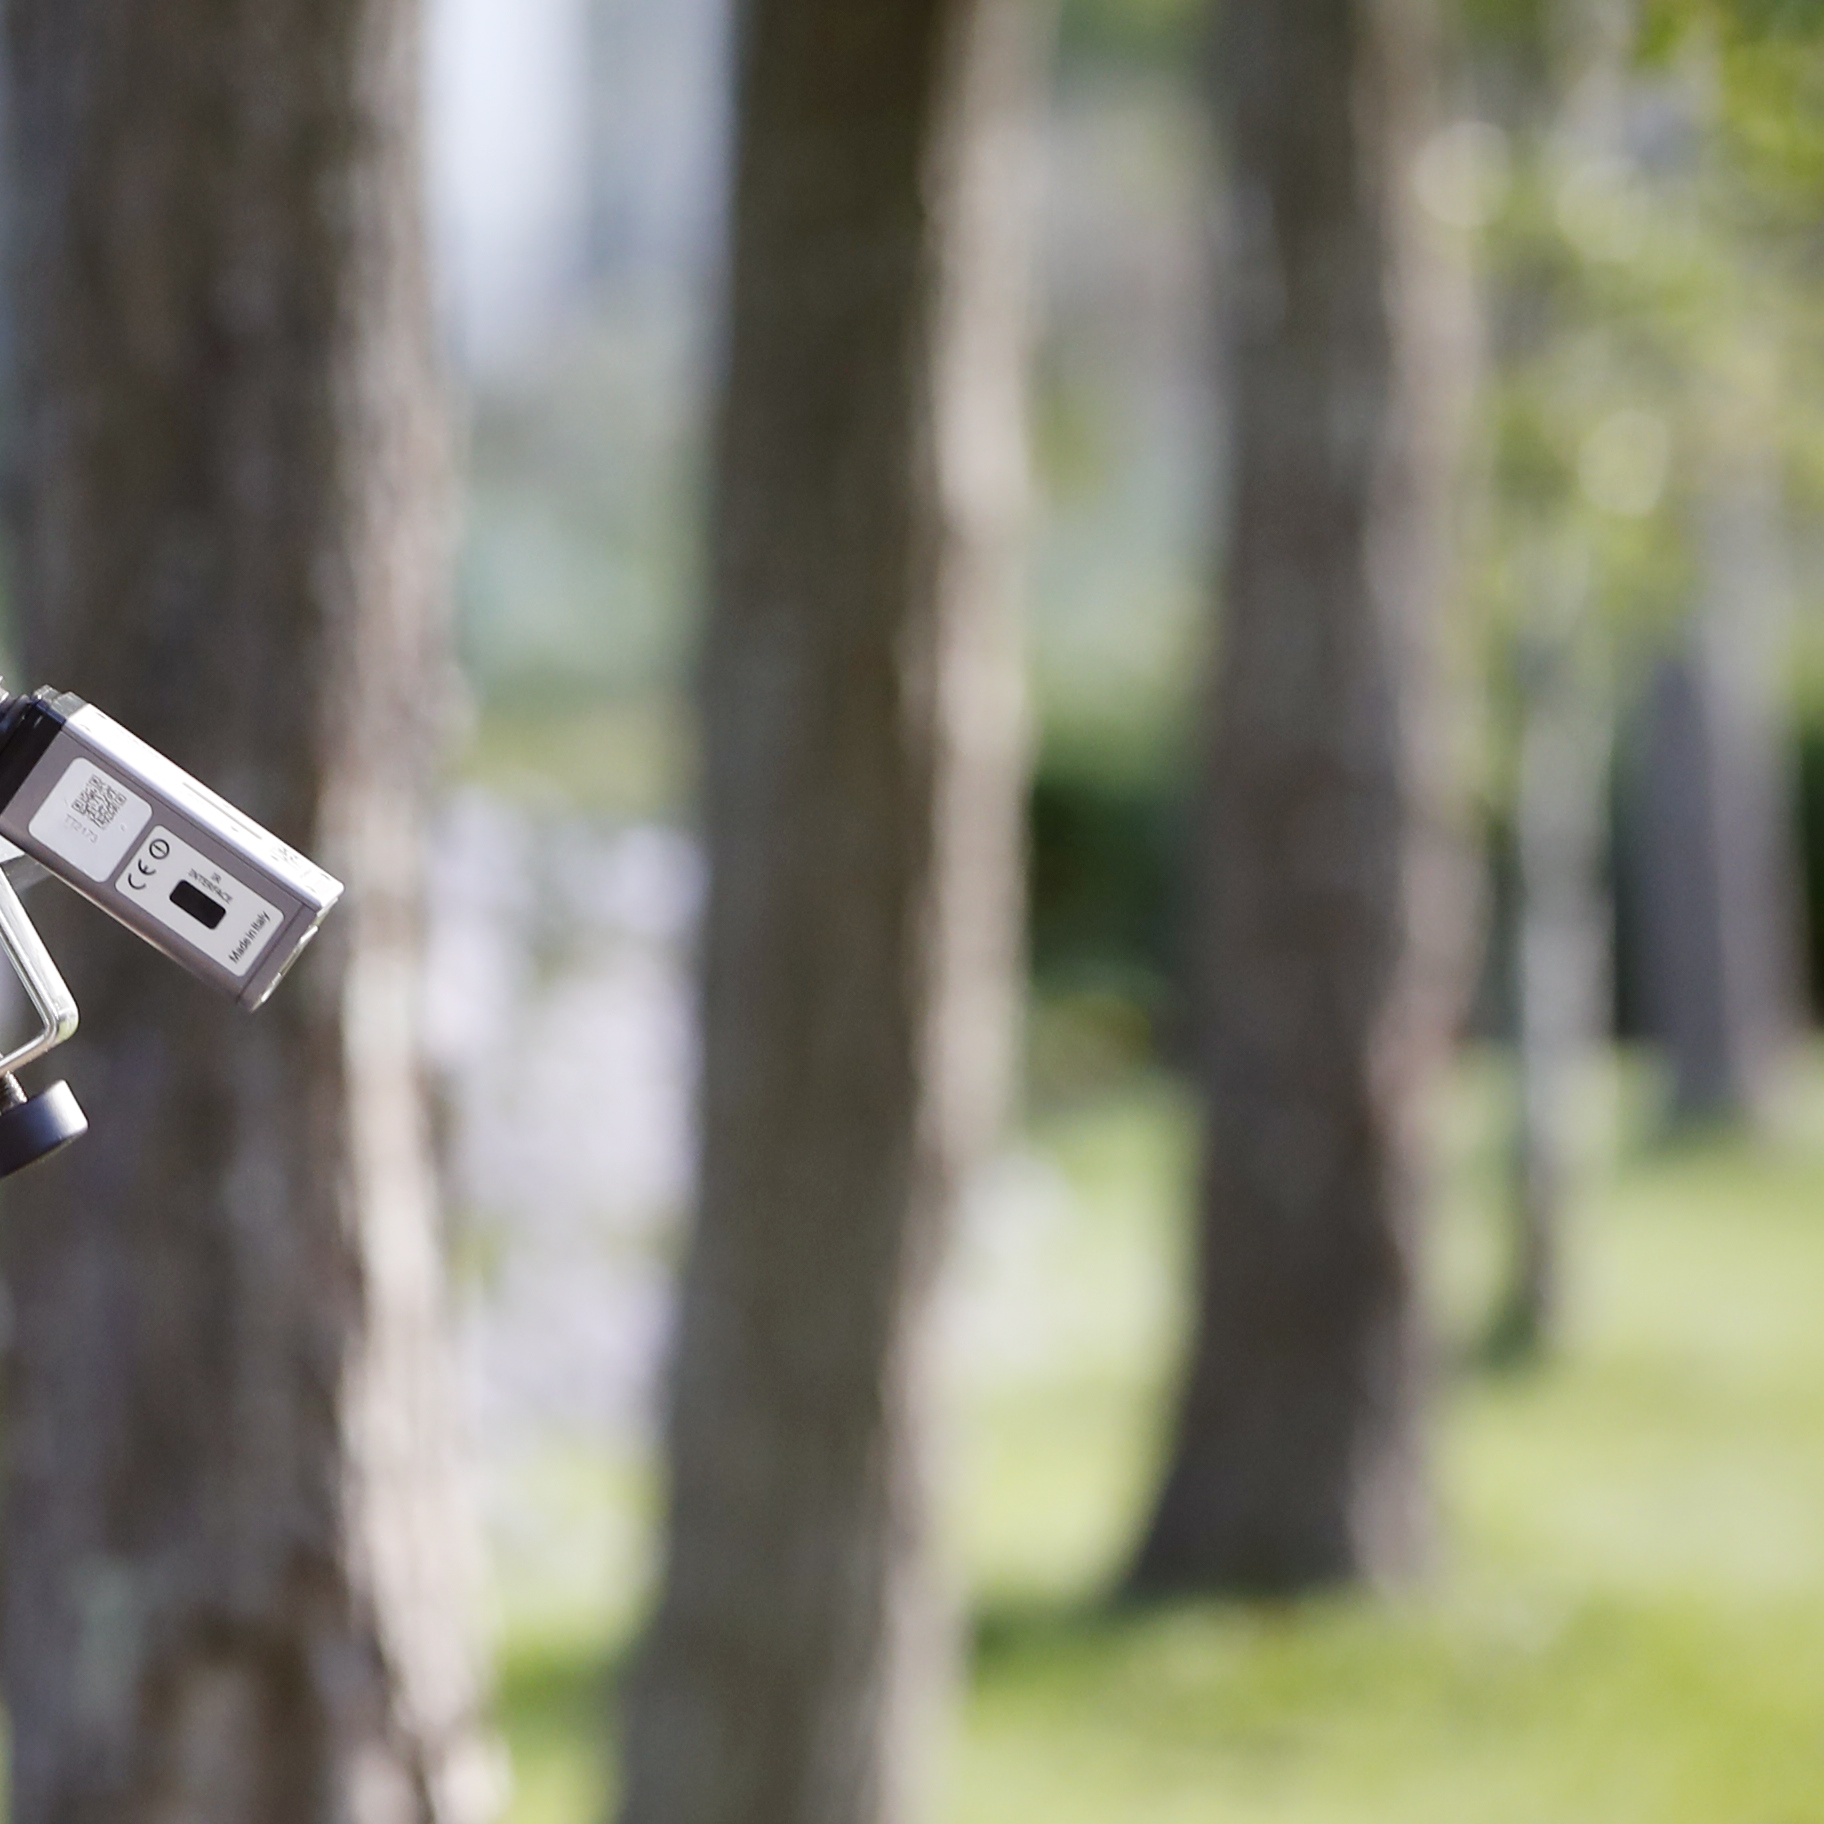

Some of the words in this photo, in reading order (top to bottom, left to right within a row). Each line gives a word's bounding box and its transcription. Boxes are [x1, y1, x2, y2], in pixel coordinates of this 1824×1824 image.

[188, 867, 233, 905] INTERFACE
[250, 910, 271, 932] Italy
[245, 929, 258, 941] in
[228, 937, 252, 964] Made
